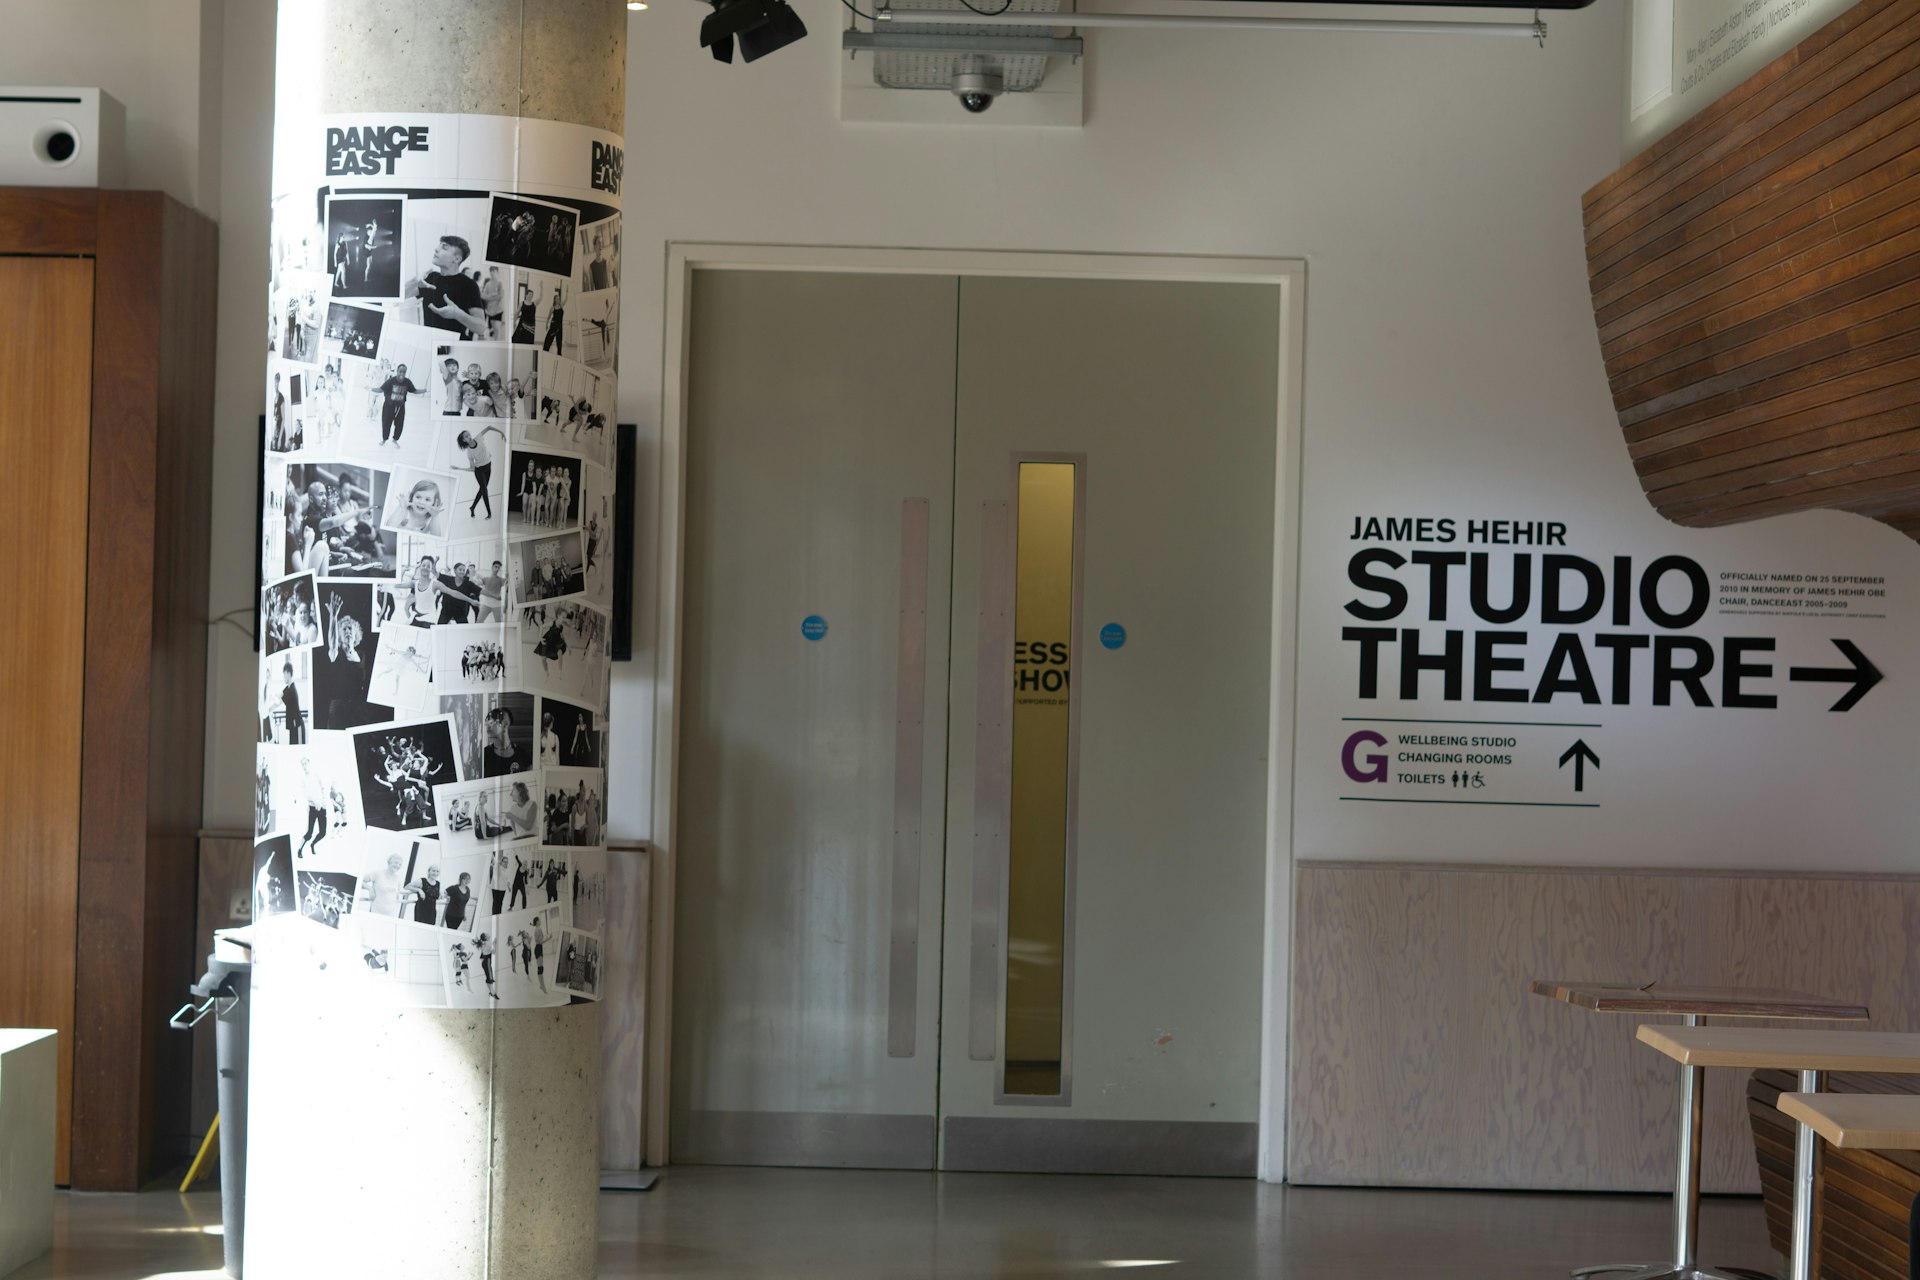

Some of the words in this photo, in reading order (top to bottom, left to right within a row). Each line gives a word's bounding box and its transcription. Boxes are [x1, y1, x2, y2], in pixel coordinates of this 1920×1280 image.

[327, 126, 428, 151] DANCE
[326, 150, 401, 176] EAST
[1350, 516, 1456, 543] JAMES
[1467, 519, 1567, 546] HEHIR
[1719, 572, 1768, 581] OFFICIALLY
[1770, 574, 1802, 582] NAMED
[1804, 575, 1818, 583] ON
[1820, 575, 1830, 583] 25
[1831, 576, 1885, 584] SEPTEMBER
[1343, 547, 1710, 629] STUDIO
[1740, 585, 1749, 593] IN
[1751, 586, 1791, 594] MEMORY
[1793, 587, 1805, 595] OF
[1807, 587, 1836, 596] JAMES
[1838, 588, 1865, 597] HEHIR
[1867, 589, 1886, 597] OBE
[1719, 597, 1749, 606] CHAIR,
[1751, 598, 1802, 607] DANCEEAST
[1342, 627, 1777, 709] THEATRE
[1398, 735, 1468, 746] WELLBEING
[1471, 736, 1517, 747] STUDIO
[1341, 730, 1388, 783] G
[1398, 752, 1462, 763] CHANGING
[1466, 754, 1512, 764] ROOMS
[1397, 773, 1445, 784] TOILETS
